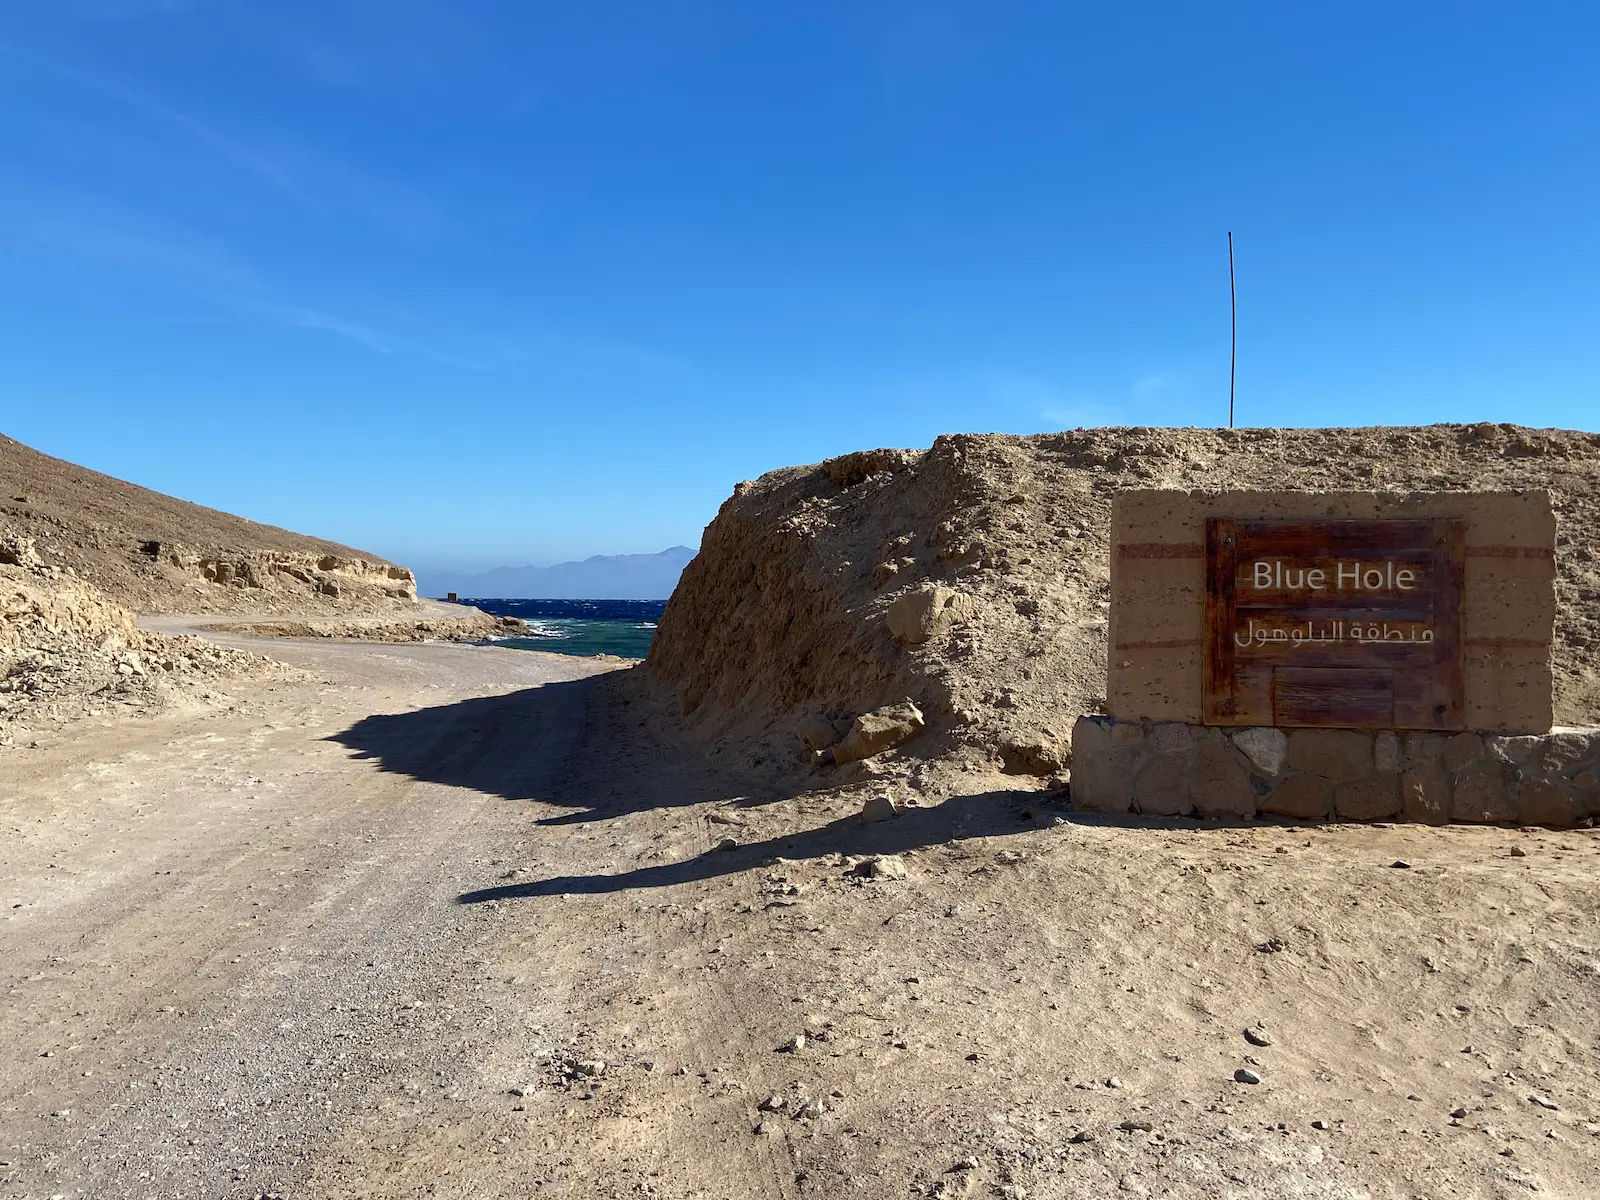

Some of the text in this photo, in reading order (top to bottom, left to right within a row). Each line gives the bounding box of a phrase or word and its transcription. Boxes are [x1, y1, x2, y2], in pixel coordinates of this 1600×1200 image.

[1253, 561, 1416, 591] Blue Hole
[1234, 620, 1434, 648] منطقة البلوهول
